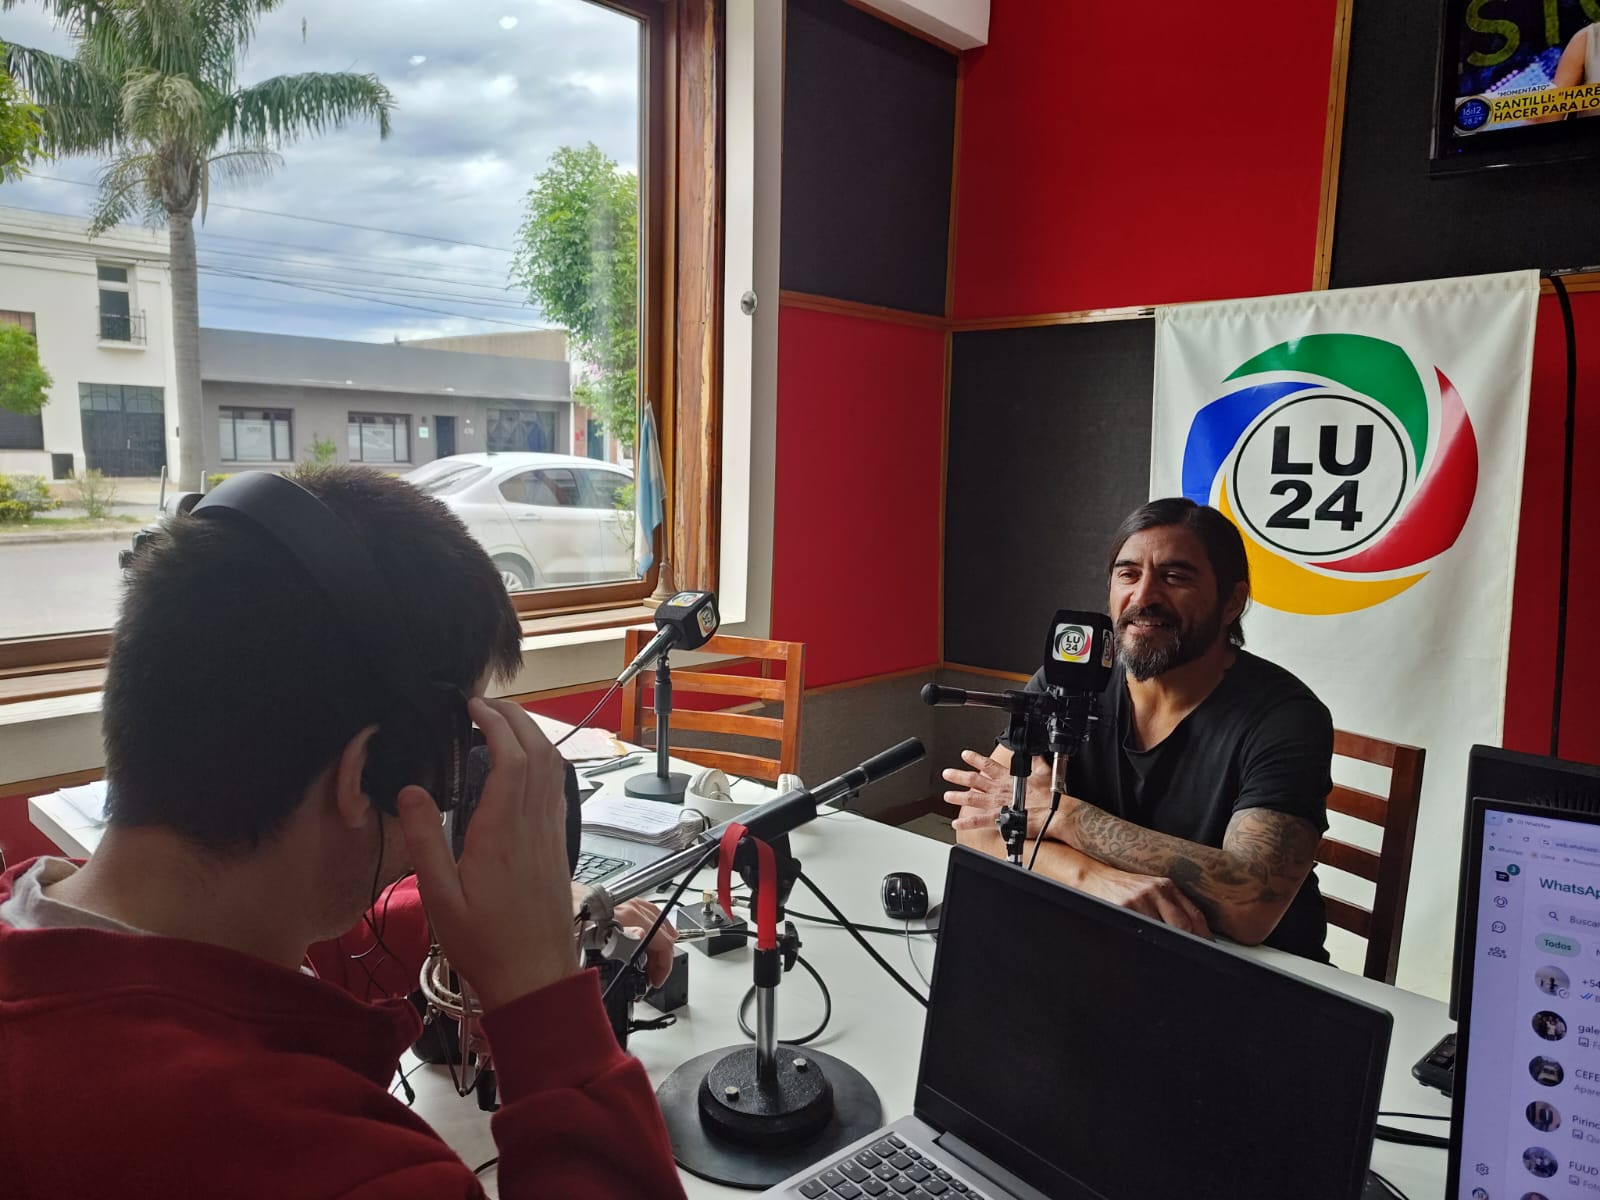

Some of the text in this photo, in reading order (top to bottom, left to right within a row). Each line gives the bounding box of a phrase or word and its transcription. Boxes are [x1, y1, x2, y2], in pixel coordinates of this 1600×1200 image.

[1495, 94, 1555, 110] SANTILLI:
[1494, 107, 1538, 121] HACER
[1542, 101, 1577, 115] PARA
[1271, 424, 1374, 476] LU
[1265, 479, 1363, 531] 24
[1065, 643, 1078, 651] 24
[1066, 635, 1080, 643] LU
[1544, 939, 1572, 951] Todos
